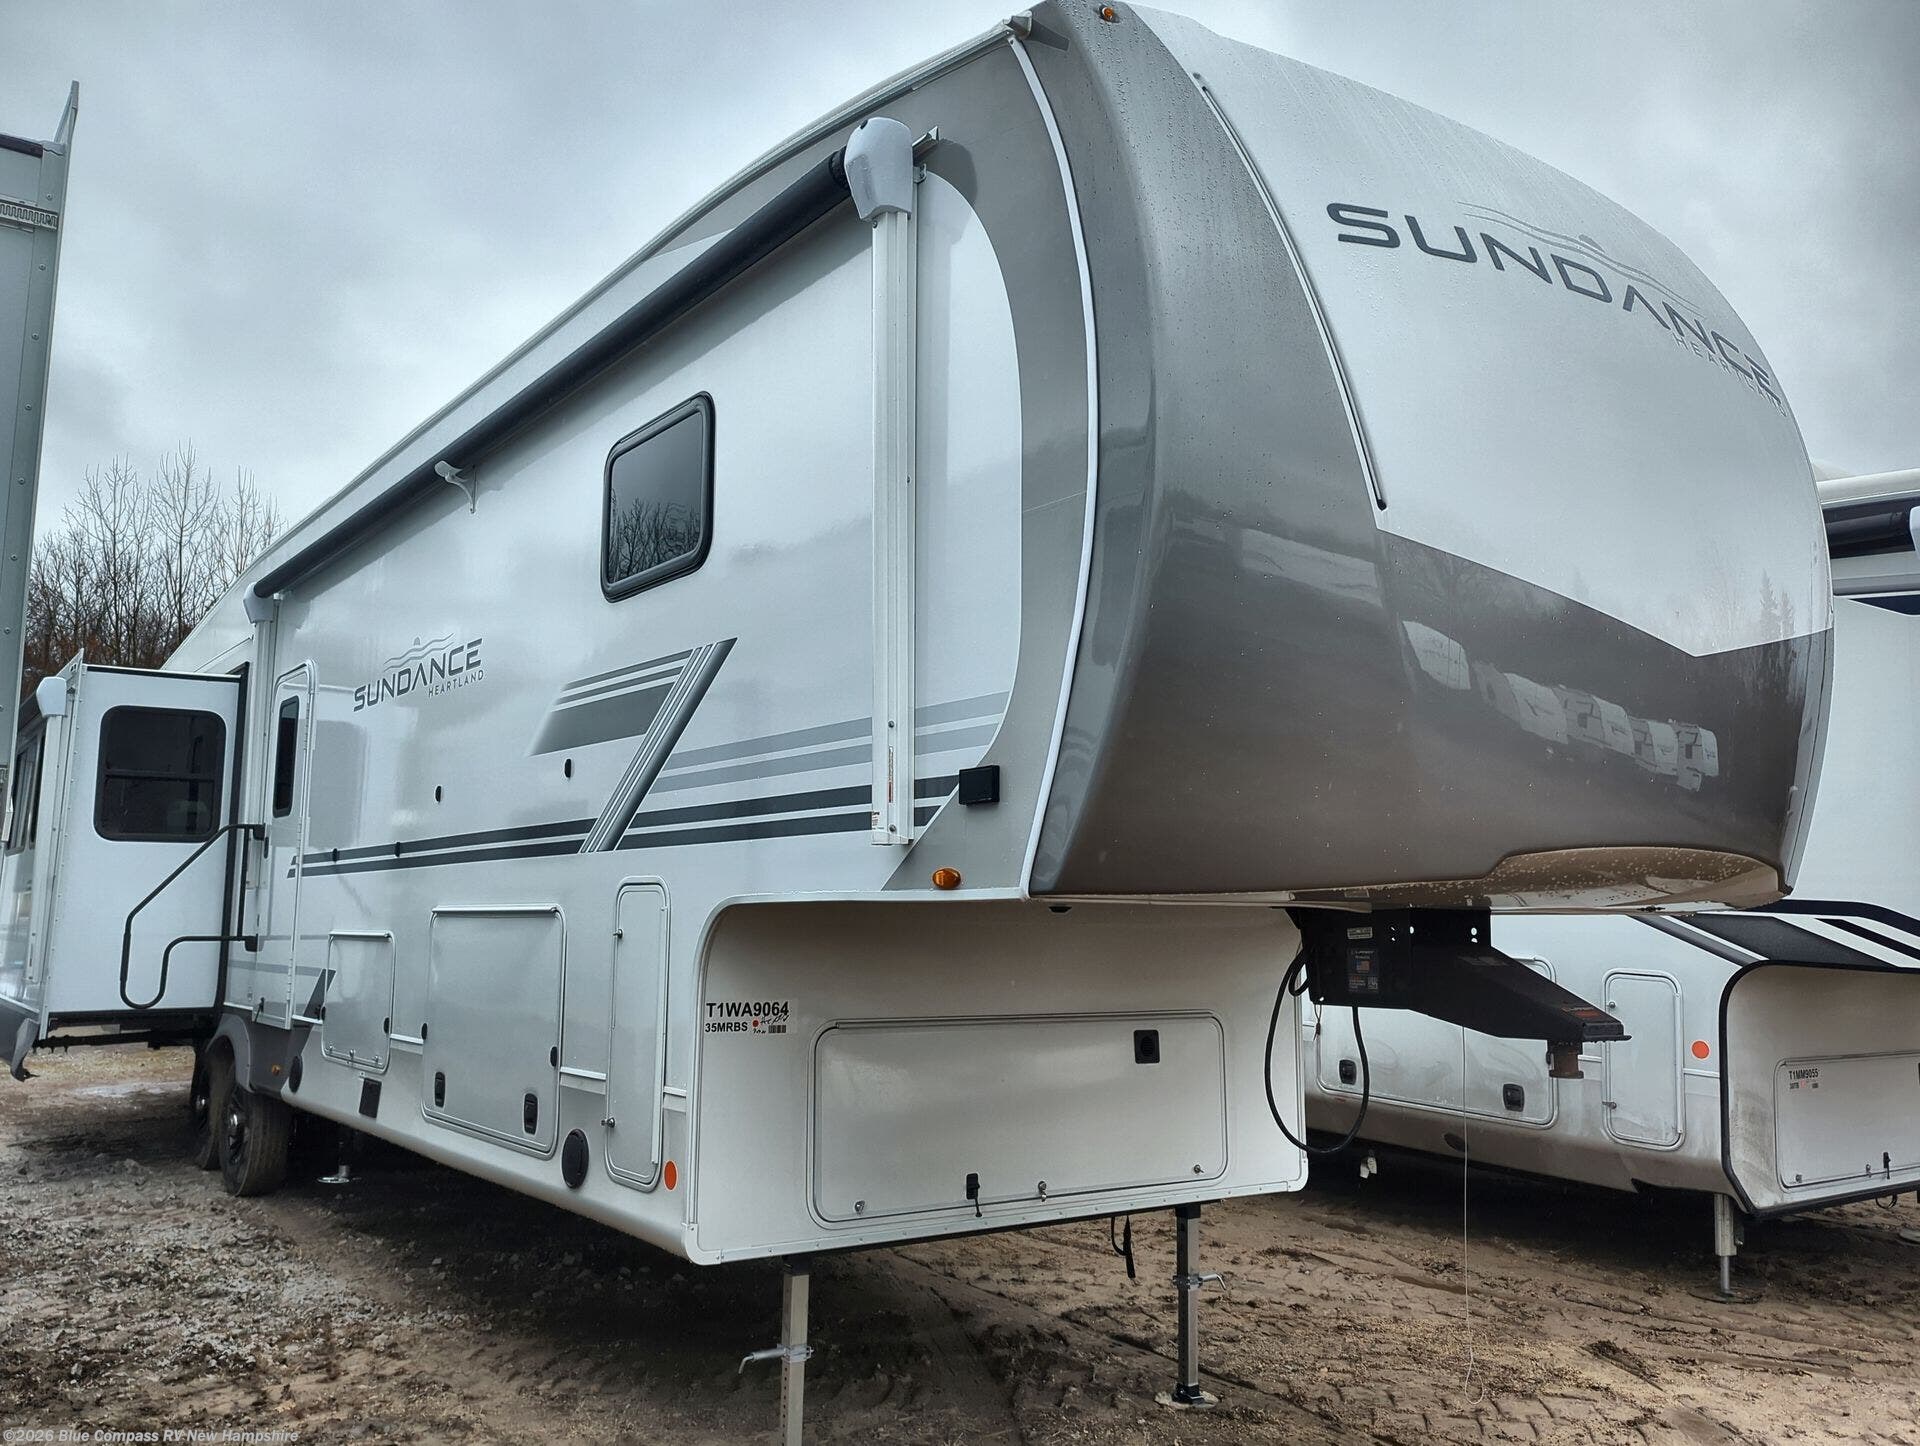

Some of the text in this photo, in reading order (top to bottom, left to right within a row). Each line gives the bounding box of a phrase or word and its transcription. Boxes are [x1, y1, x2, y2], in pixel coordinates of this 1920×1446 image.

[1326, 201, 1782, 406] SUNDANCE
[353, 637, 483, 712] SUNDANCE
[428, 669, 484, 698] HEARTLAND
[706, 1001, 789, 1018] T1WA9064
[705, 1021, 748, 1033] 35MRBS
